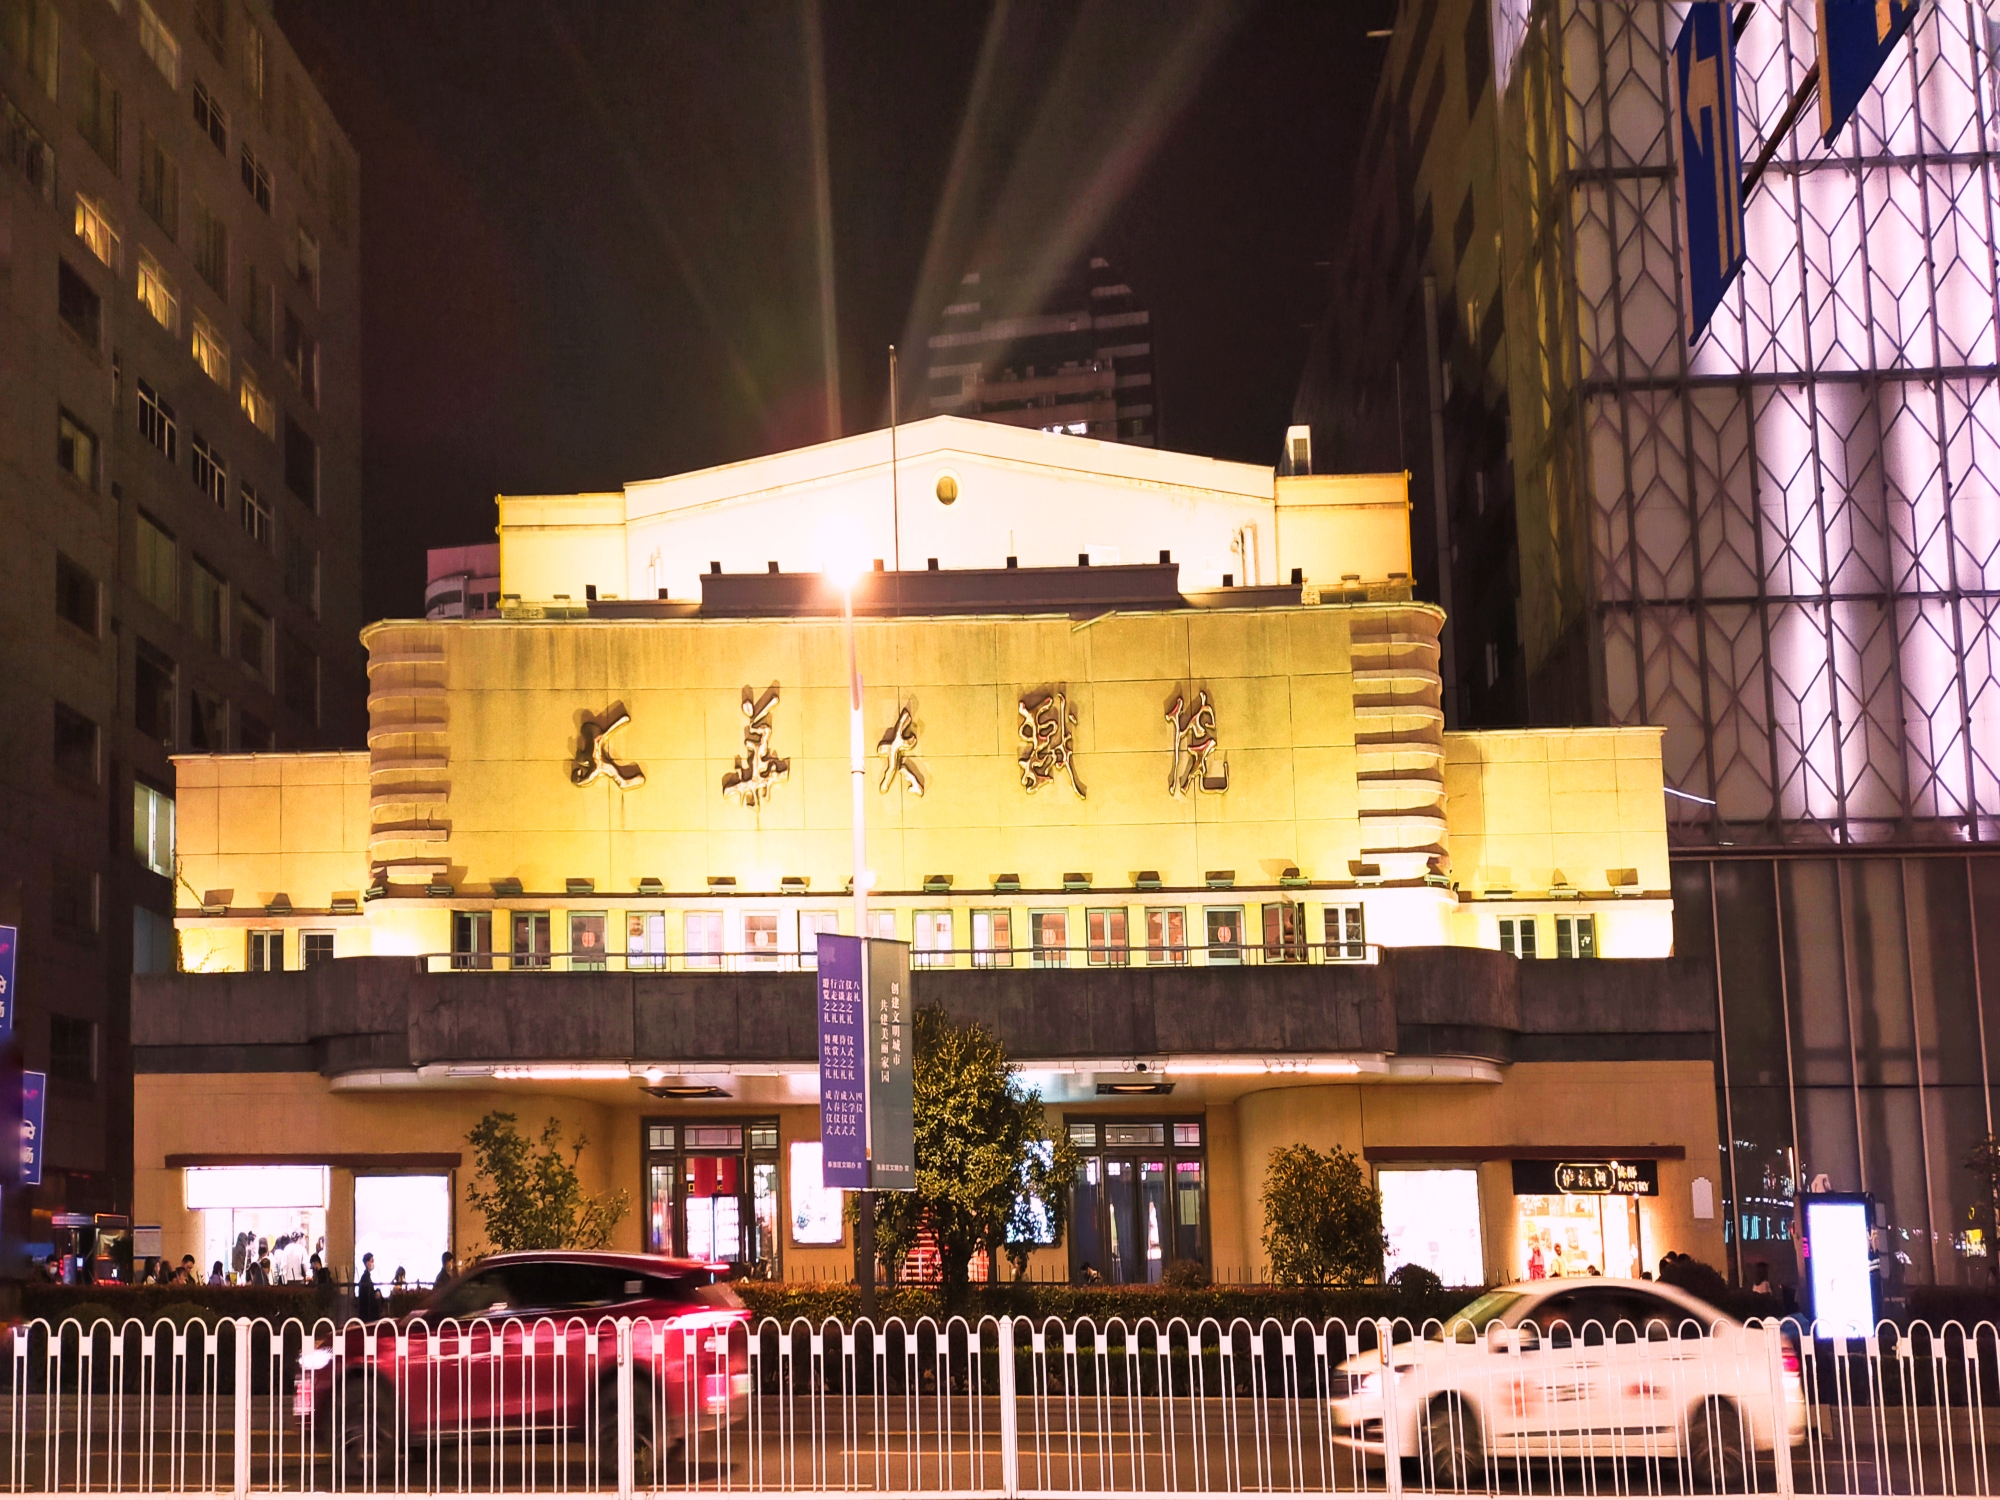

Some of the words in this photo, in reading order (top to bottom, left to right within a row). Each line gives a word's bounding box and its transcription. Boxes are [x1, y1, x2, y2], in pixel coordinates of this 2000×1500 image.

[880, 999, 890, 1083] 共建美丽家园
[891, 982, 901, 1066] 创建文明城市
[1617, 1181, 1650, 1192] PASTRY
